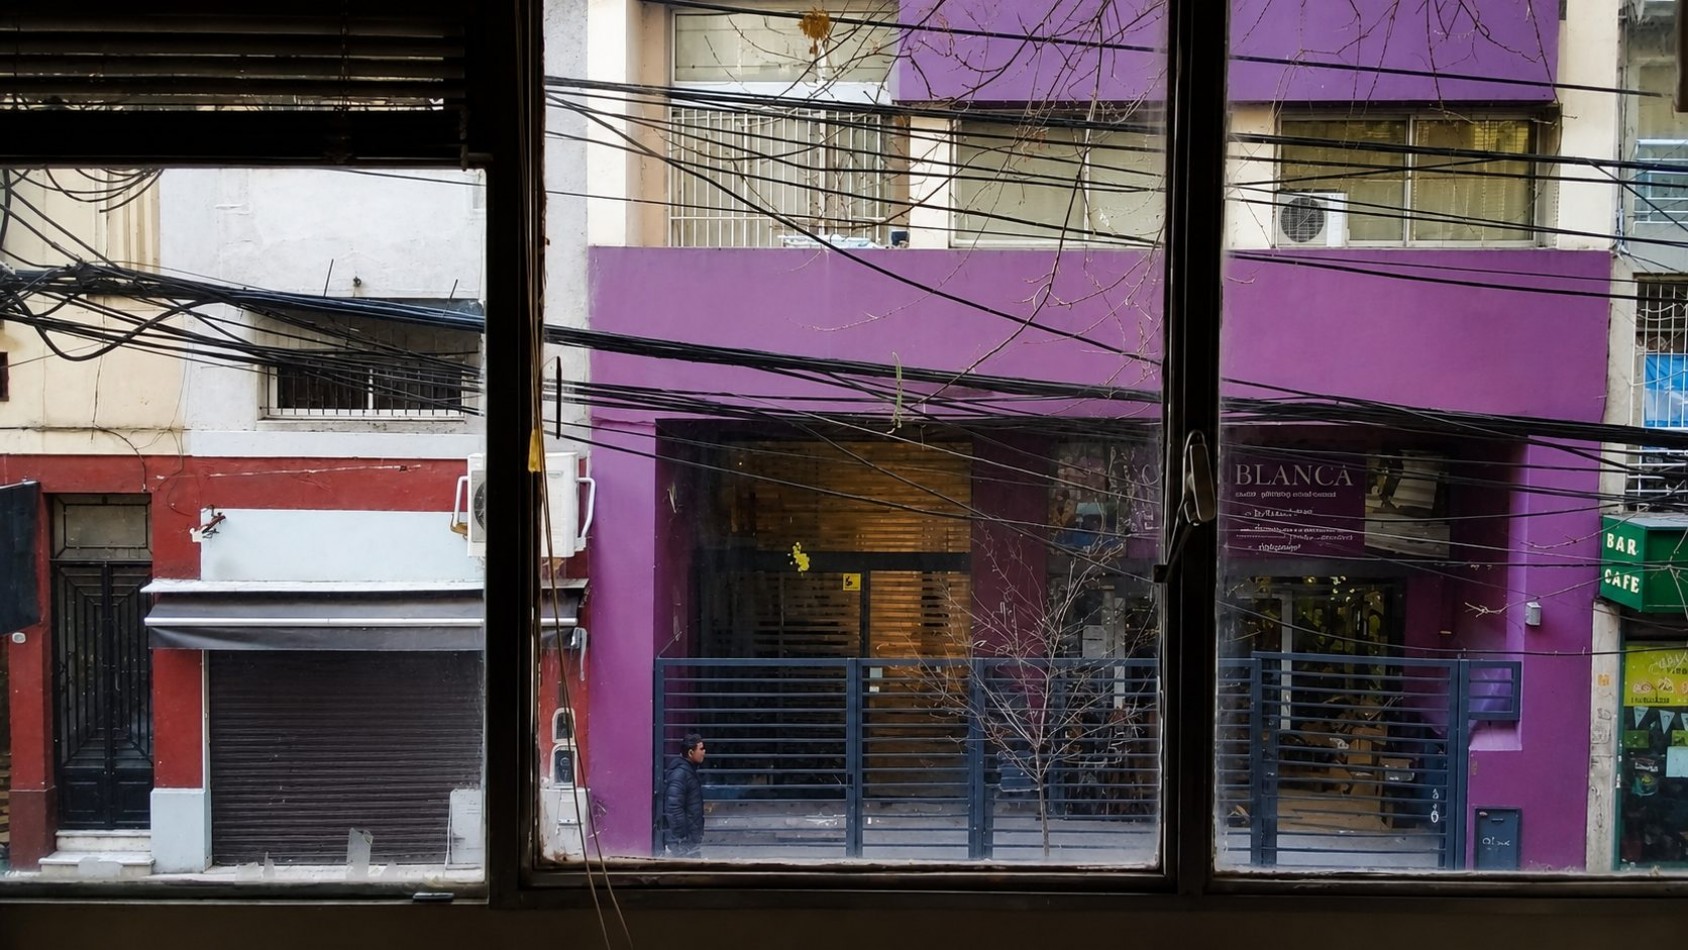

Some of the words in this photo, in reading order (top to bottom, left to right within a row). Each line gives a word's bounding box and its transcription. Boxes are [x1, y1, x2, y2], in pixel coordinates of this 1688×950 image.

[1235, 463, 1353, 486] BLANCA
[1606, 532, 1637, 556] BAR
[1604, 568, 1640, 593] CAFE
